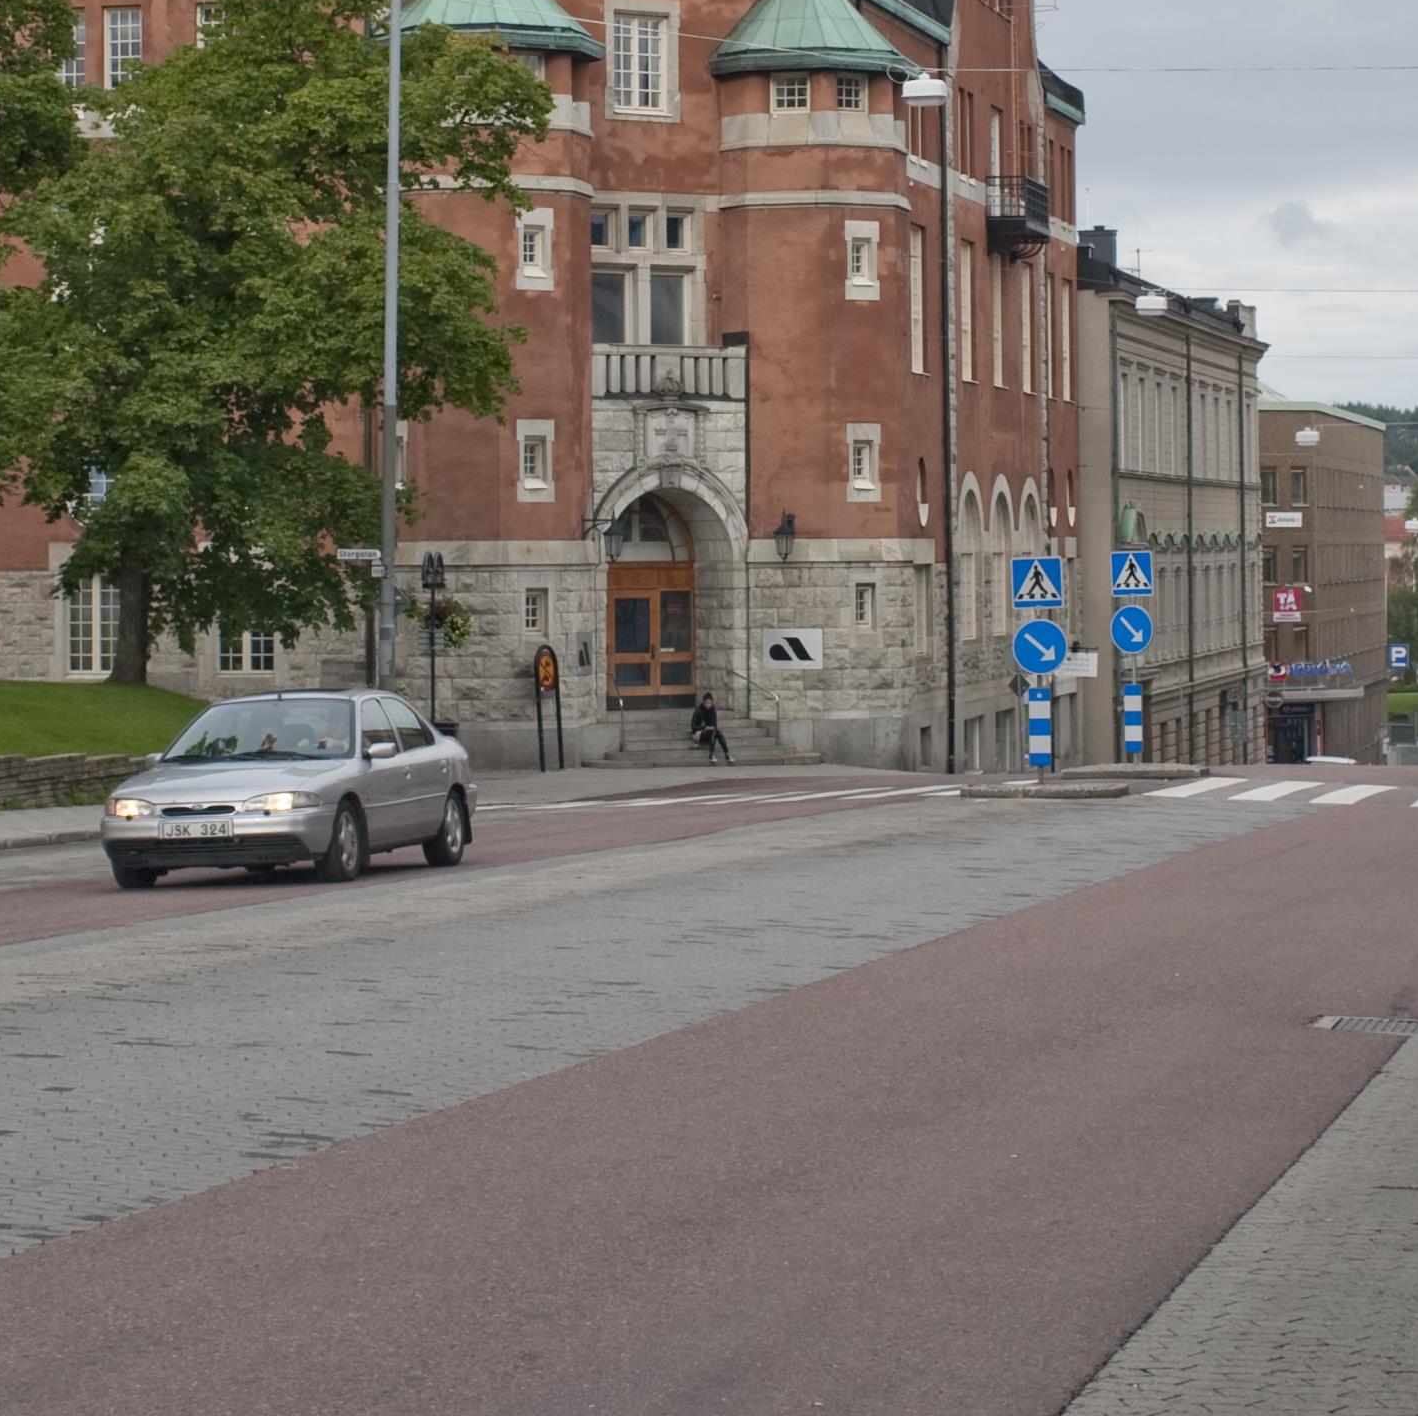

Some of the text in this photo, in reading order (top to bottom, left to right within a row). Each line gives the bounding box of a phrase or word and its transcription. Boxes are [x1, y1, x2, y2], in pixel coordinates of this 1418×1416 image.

[338, 550, 377, 559] Storgatan
[166, 823, 226, 837] JSK 324
